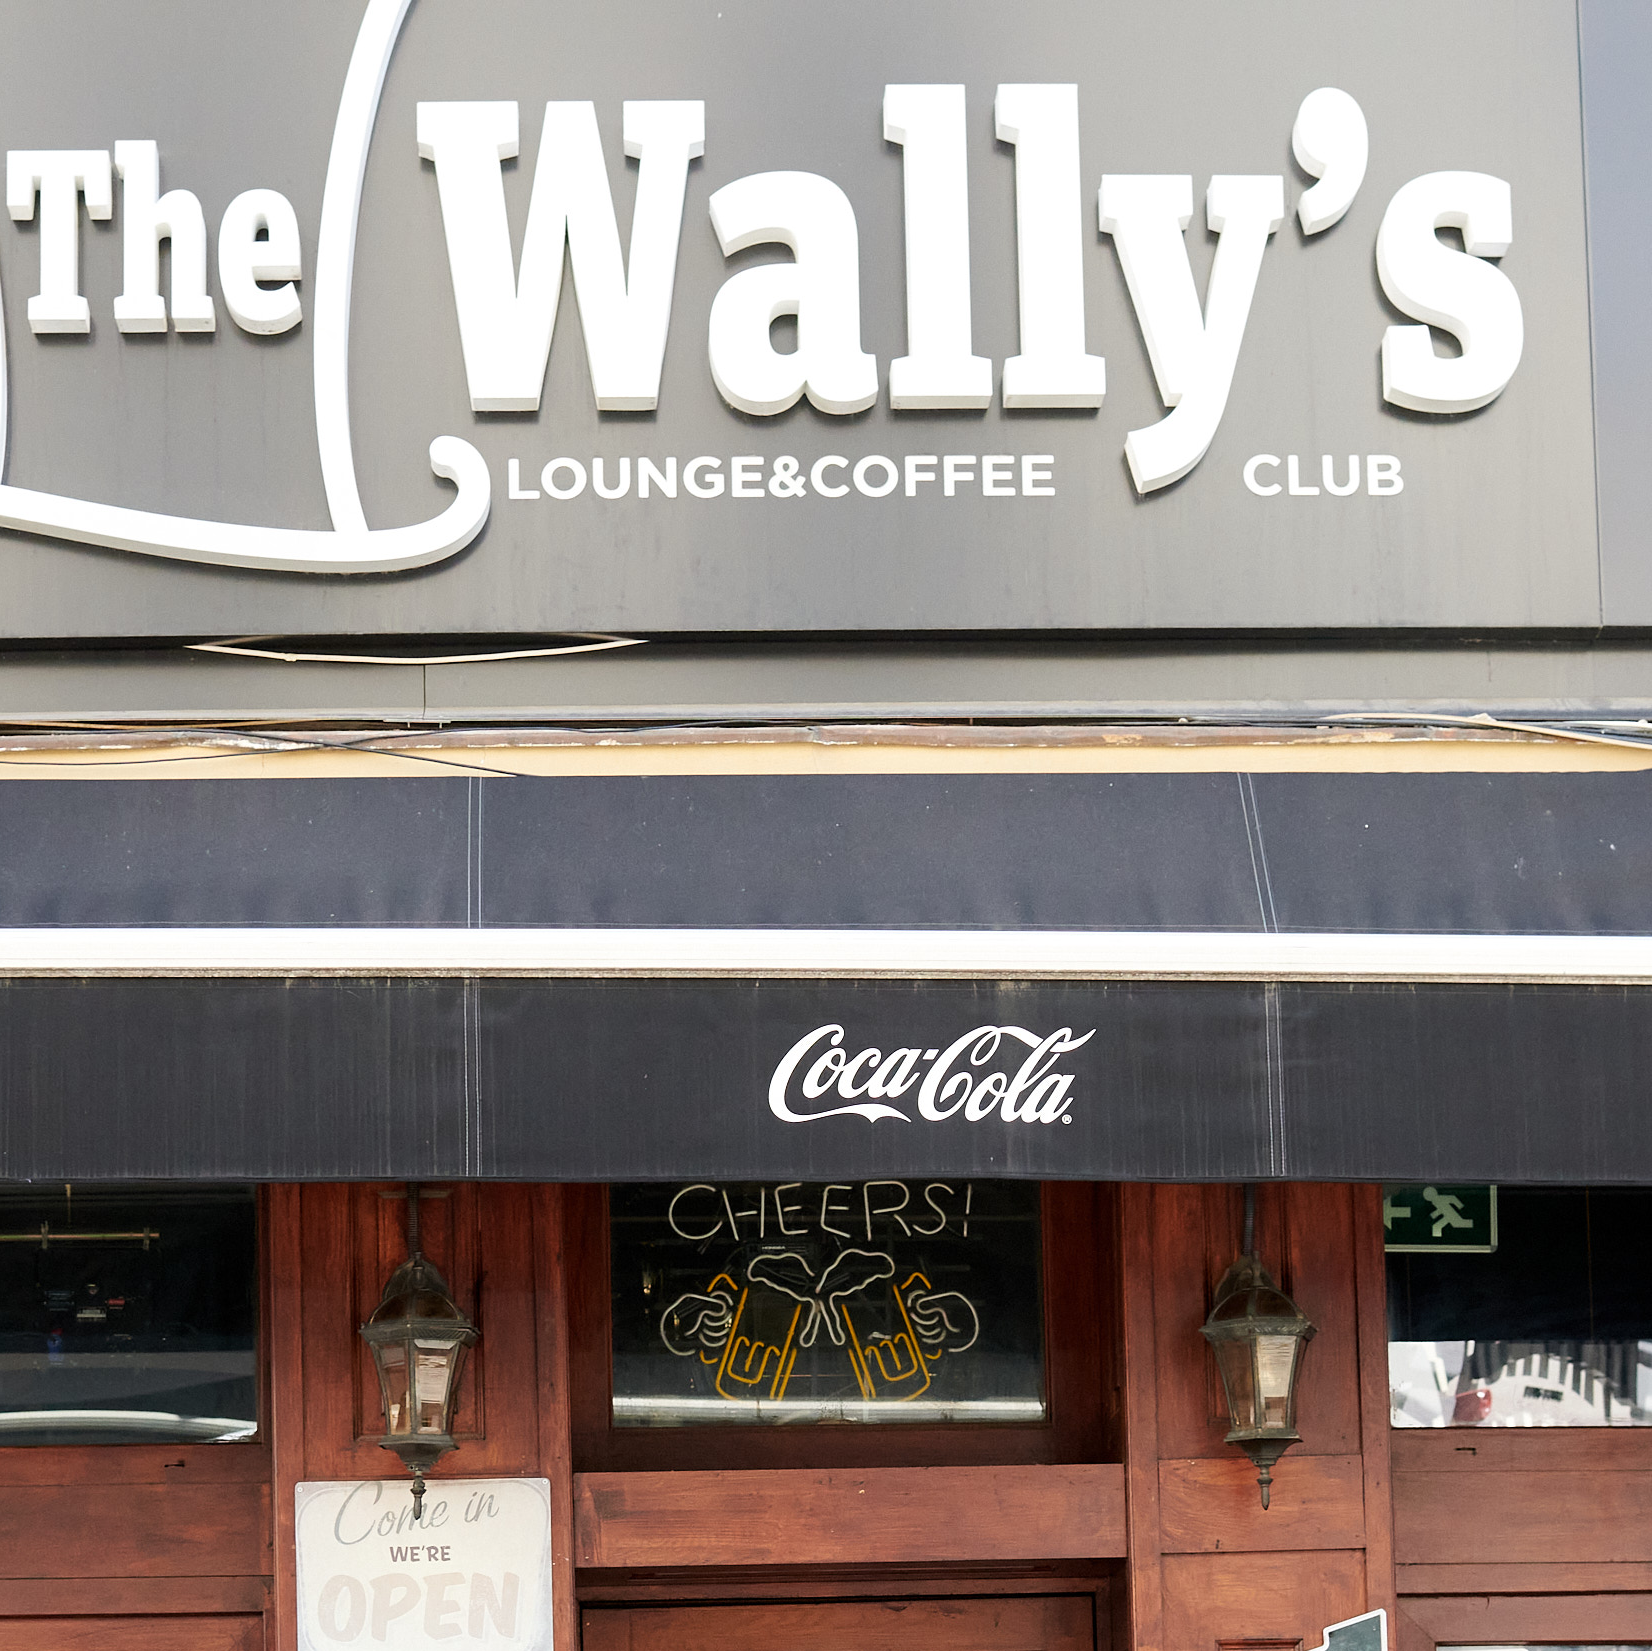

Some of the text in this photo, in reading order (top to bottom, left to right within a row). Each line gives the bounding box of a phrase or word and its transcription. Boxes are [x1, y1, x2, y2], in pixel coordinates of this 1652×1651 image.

[7, 83, 1524, 496] The Wally's
[507, 453, 1404, 500] LOUNGE&COFFEE CLUB
[768, 1023, 1097, 1124] Coca-Cola
[668, 1181, 972, 1241] CHEERS!
[333, 1481, 500, 1545] Come in
[389, 1544, 452, 1563] WE'RE
[317, 1571, 521, 1643] OPEN
